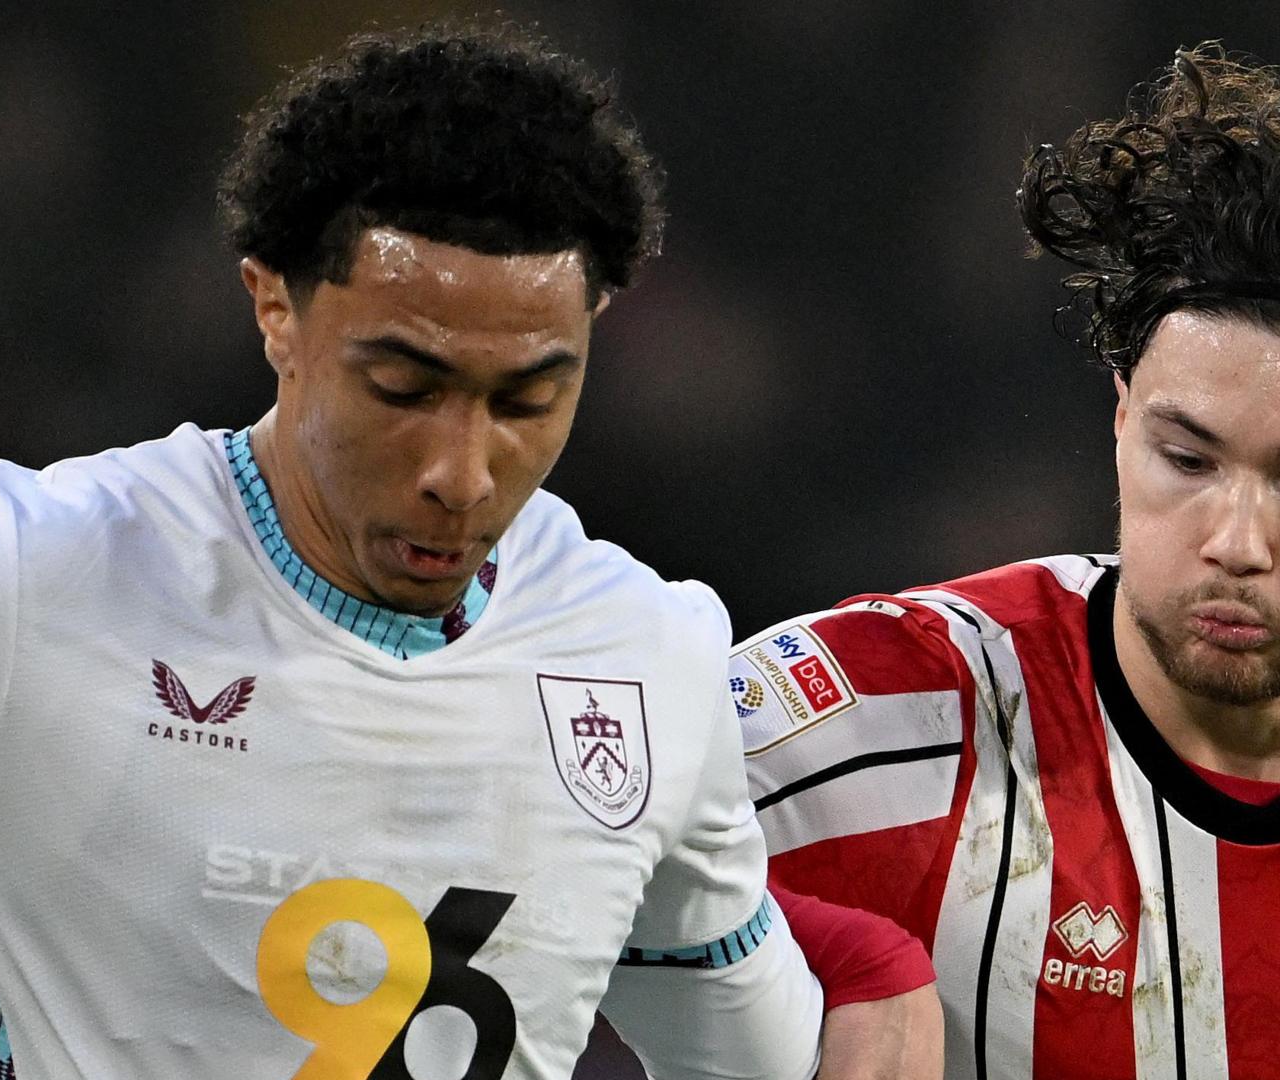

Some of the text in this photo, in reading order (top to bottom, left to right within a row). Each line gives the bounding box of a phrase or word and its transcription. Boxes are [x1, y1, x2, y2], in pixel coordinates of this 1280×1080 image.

[749, 647, 809, 721] CHAMPIONSHIP
[773, 635, 834, 705] sky bet
[148, 723, 248, 752] CASTORE
